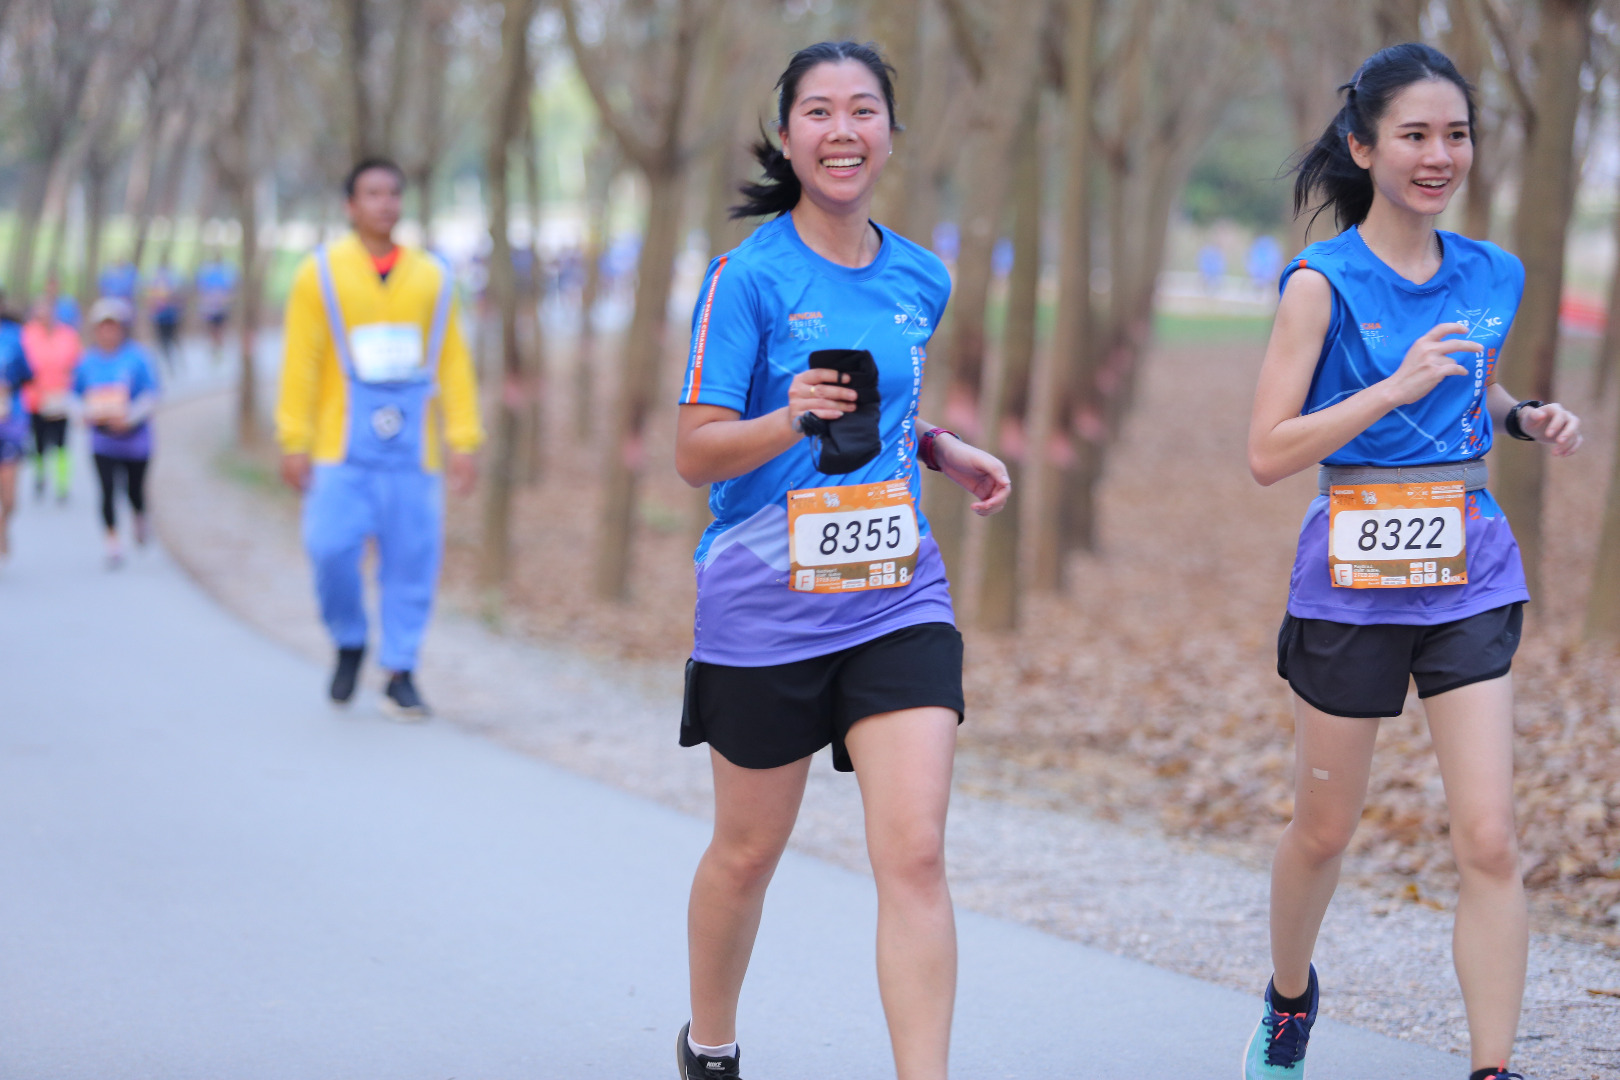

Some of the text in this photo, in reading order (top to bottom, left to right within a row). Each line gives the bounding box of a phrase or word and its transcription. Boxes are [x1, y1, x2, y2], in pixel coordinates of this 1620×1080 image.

[703, 303, 712, 323] PARK
[894, 314, 908, 324] SP
[1485, 317, 1503, 328] XC
[697, 324, 708, 353] CHIANG
[695, 355, 703, 369] RAI
[910, 345, 921, 396] CROSS
[819, 514, 902, 556] 8355
[1357, 516, 1446, 552] 8322
[801, 575, 811, 588] F
[899, 567, 908, 584] 8
[1340, 569, 1348, 582] F
[1441, 567, 1450, 583] 8
